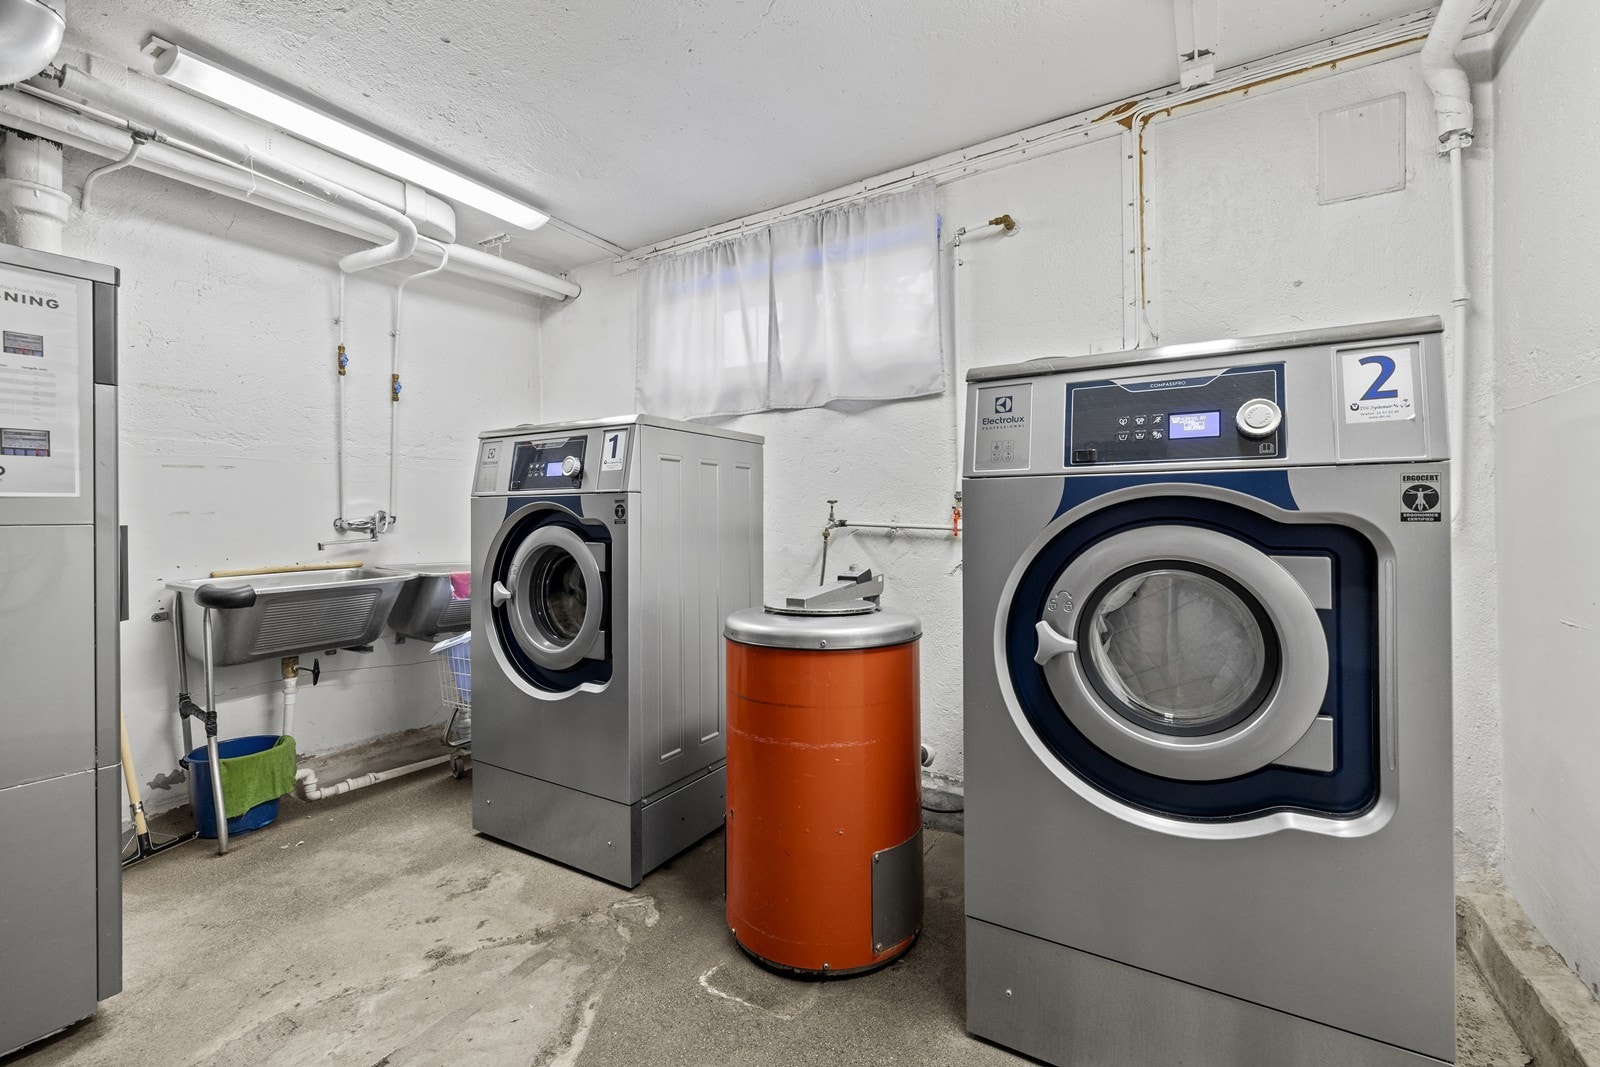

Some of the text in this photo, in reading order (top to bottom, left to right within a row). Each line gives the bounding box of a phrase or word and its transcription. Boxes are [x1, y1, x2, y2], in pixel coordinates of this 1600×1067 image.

[0, 291, 60, 309] NING
[1150, 381, 1187, 389] COMPASSPRO
[1358, 355, 1398, 401] 2
[982, 416, 1025, 426] Electrolux
[609, 434, 619, 459] 1
[1402, 474, 1439, 482] ERGOCERT
